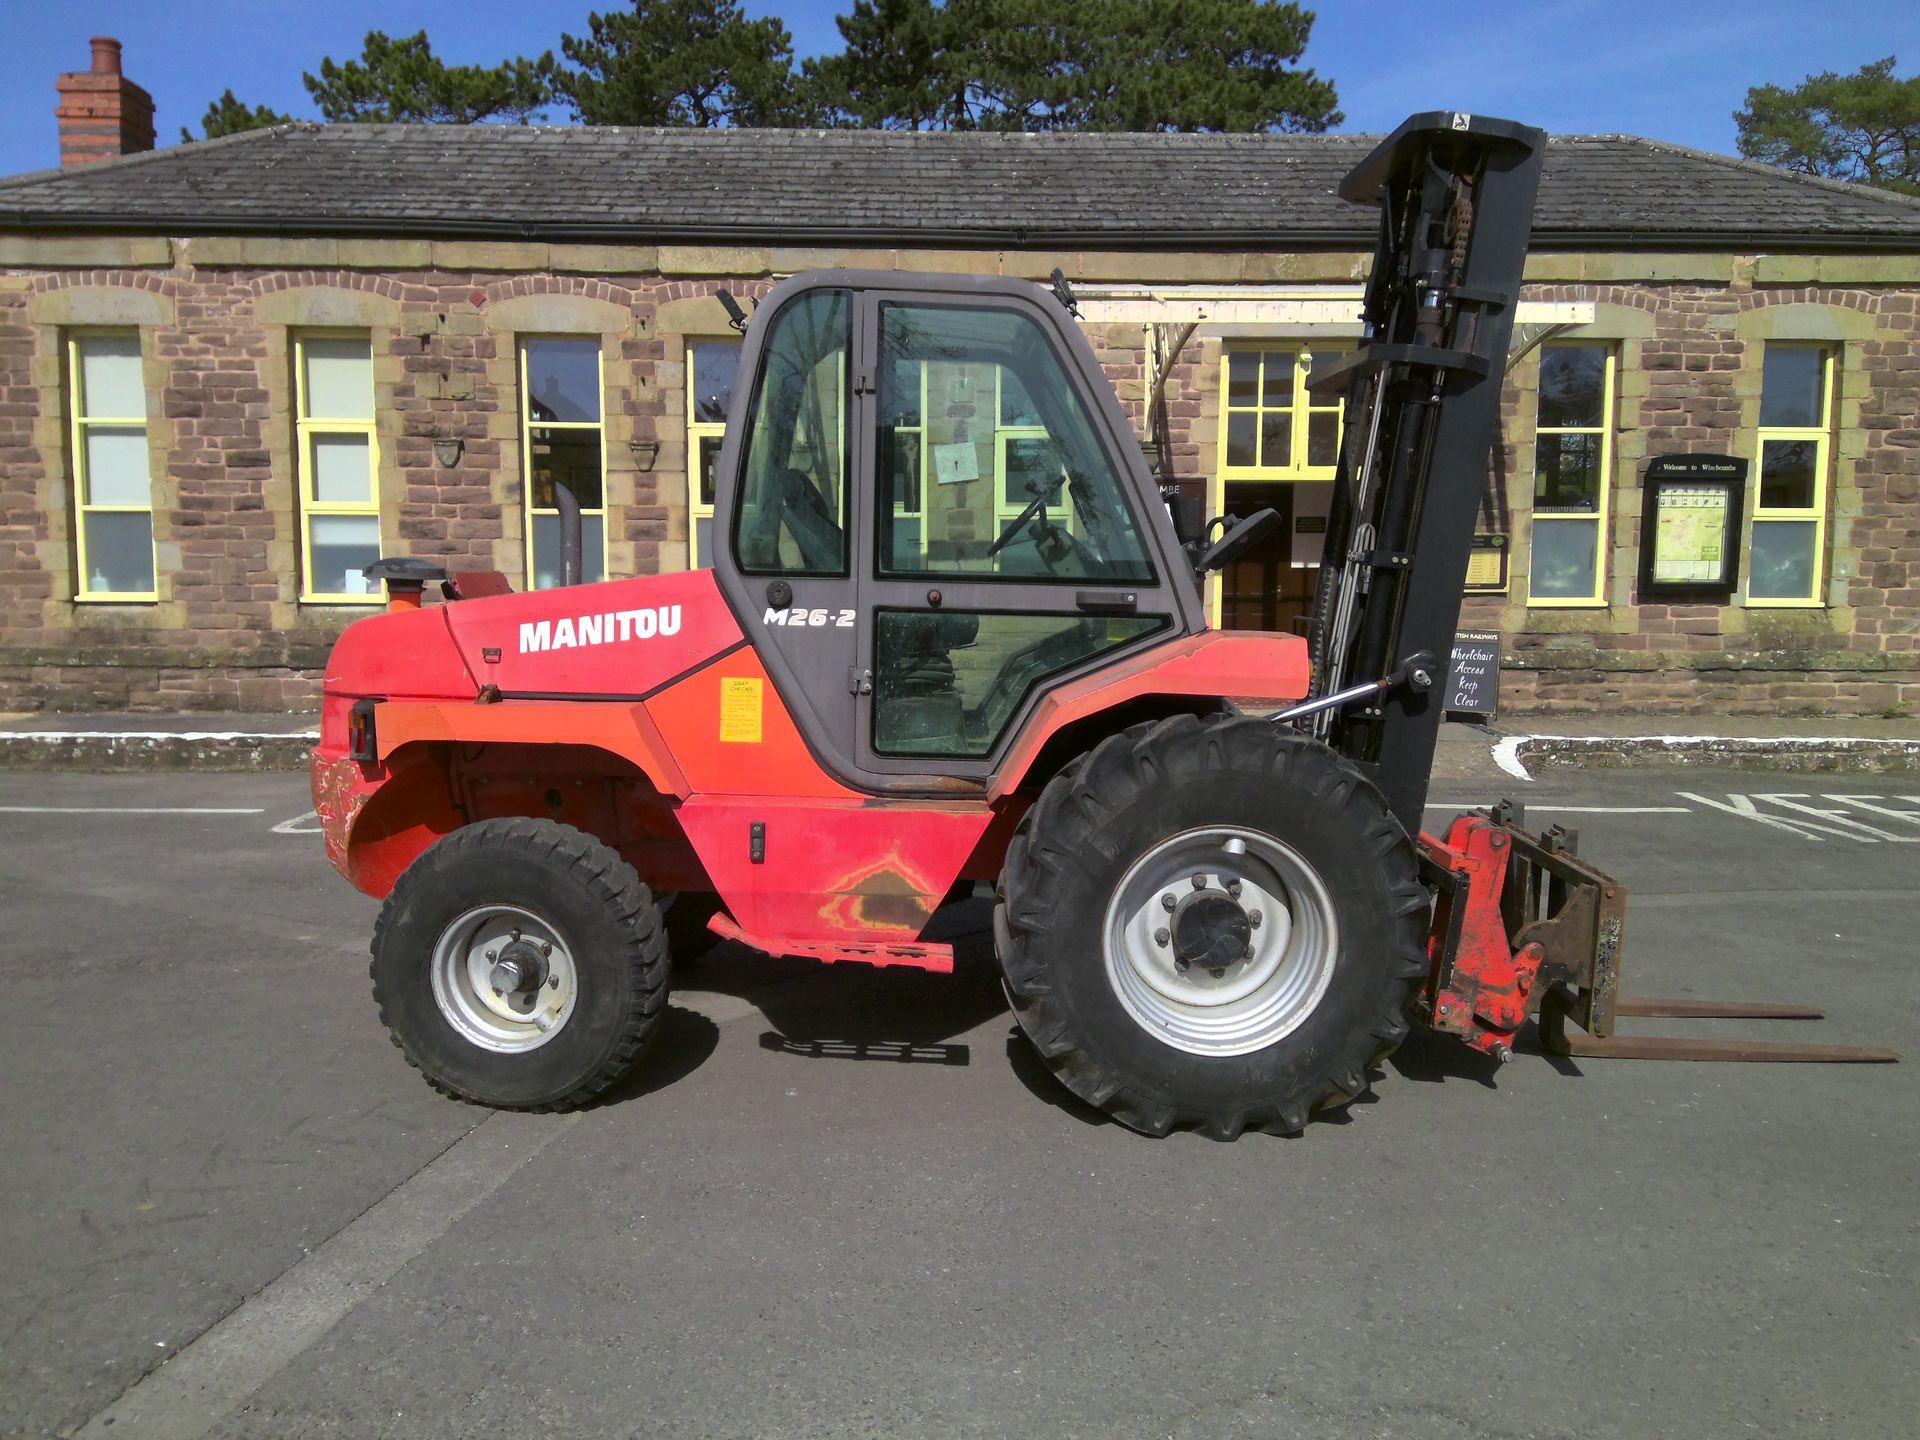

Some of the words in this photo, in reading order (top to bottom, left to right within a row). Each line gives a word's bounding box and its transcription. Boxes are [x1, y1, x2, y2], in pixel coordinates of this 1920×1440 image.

[763, 607, 857, 627] M26-2
[519, 604, 682, 653] MANITOU
[1470, 633, 1499, 641] RAILWAYS
[1450, 648, 1494, 661] Wheelchair
[1454, 660, 1485, 675] Access
[1458, 676, 1478, 695] Keep
[1454, 692, 1479, 707] Clear
